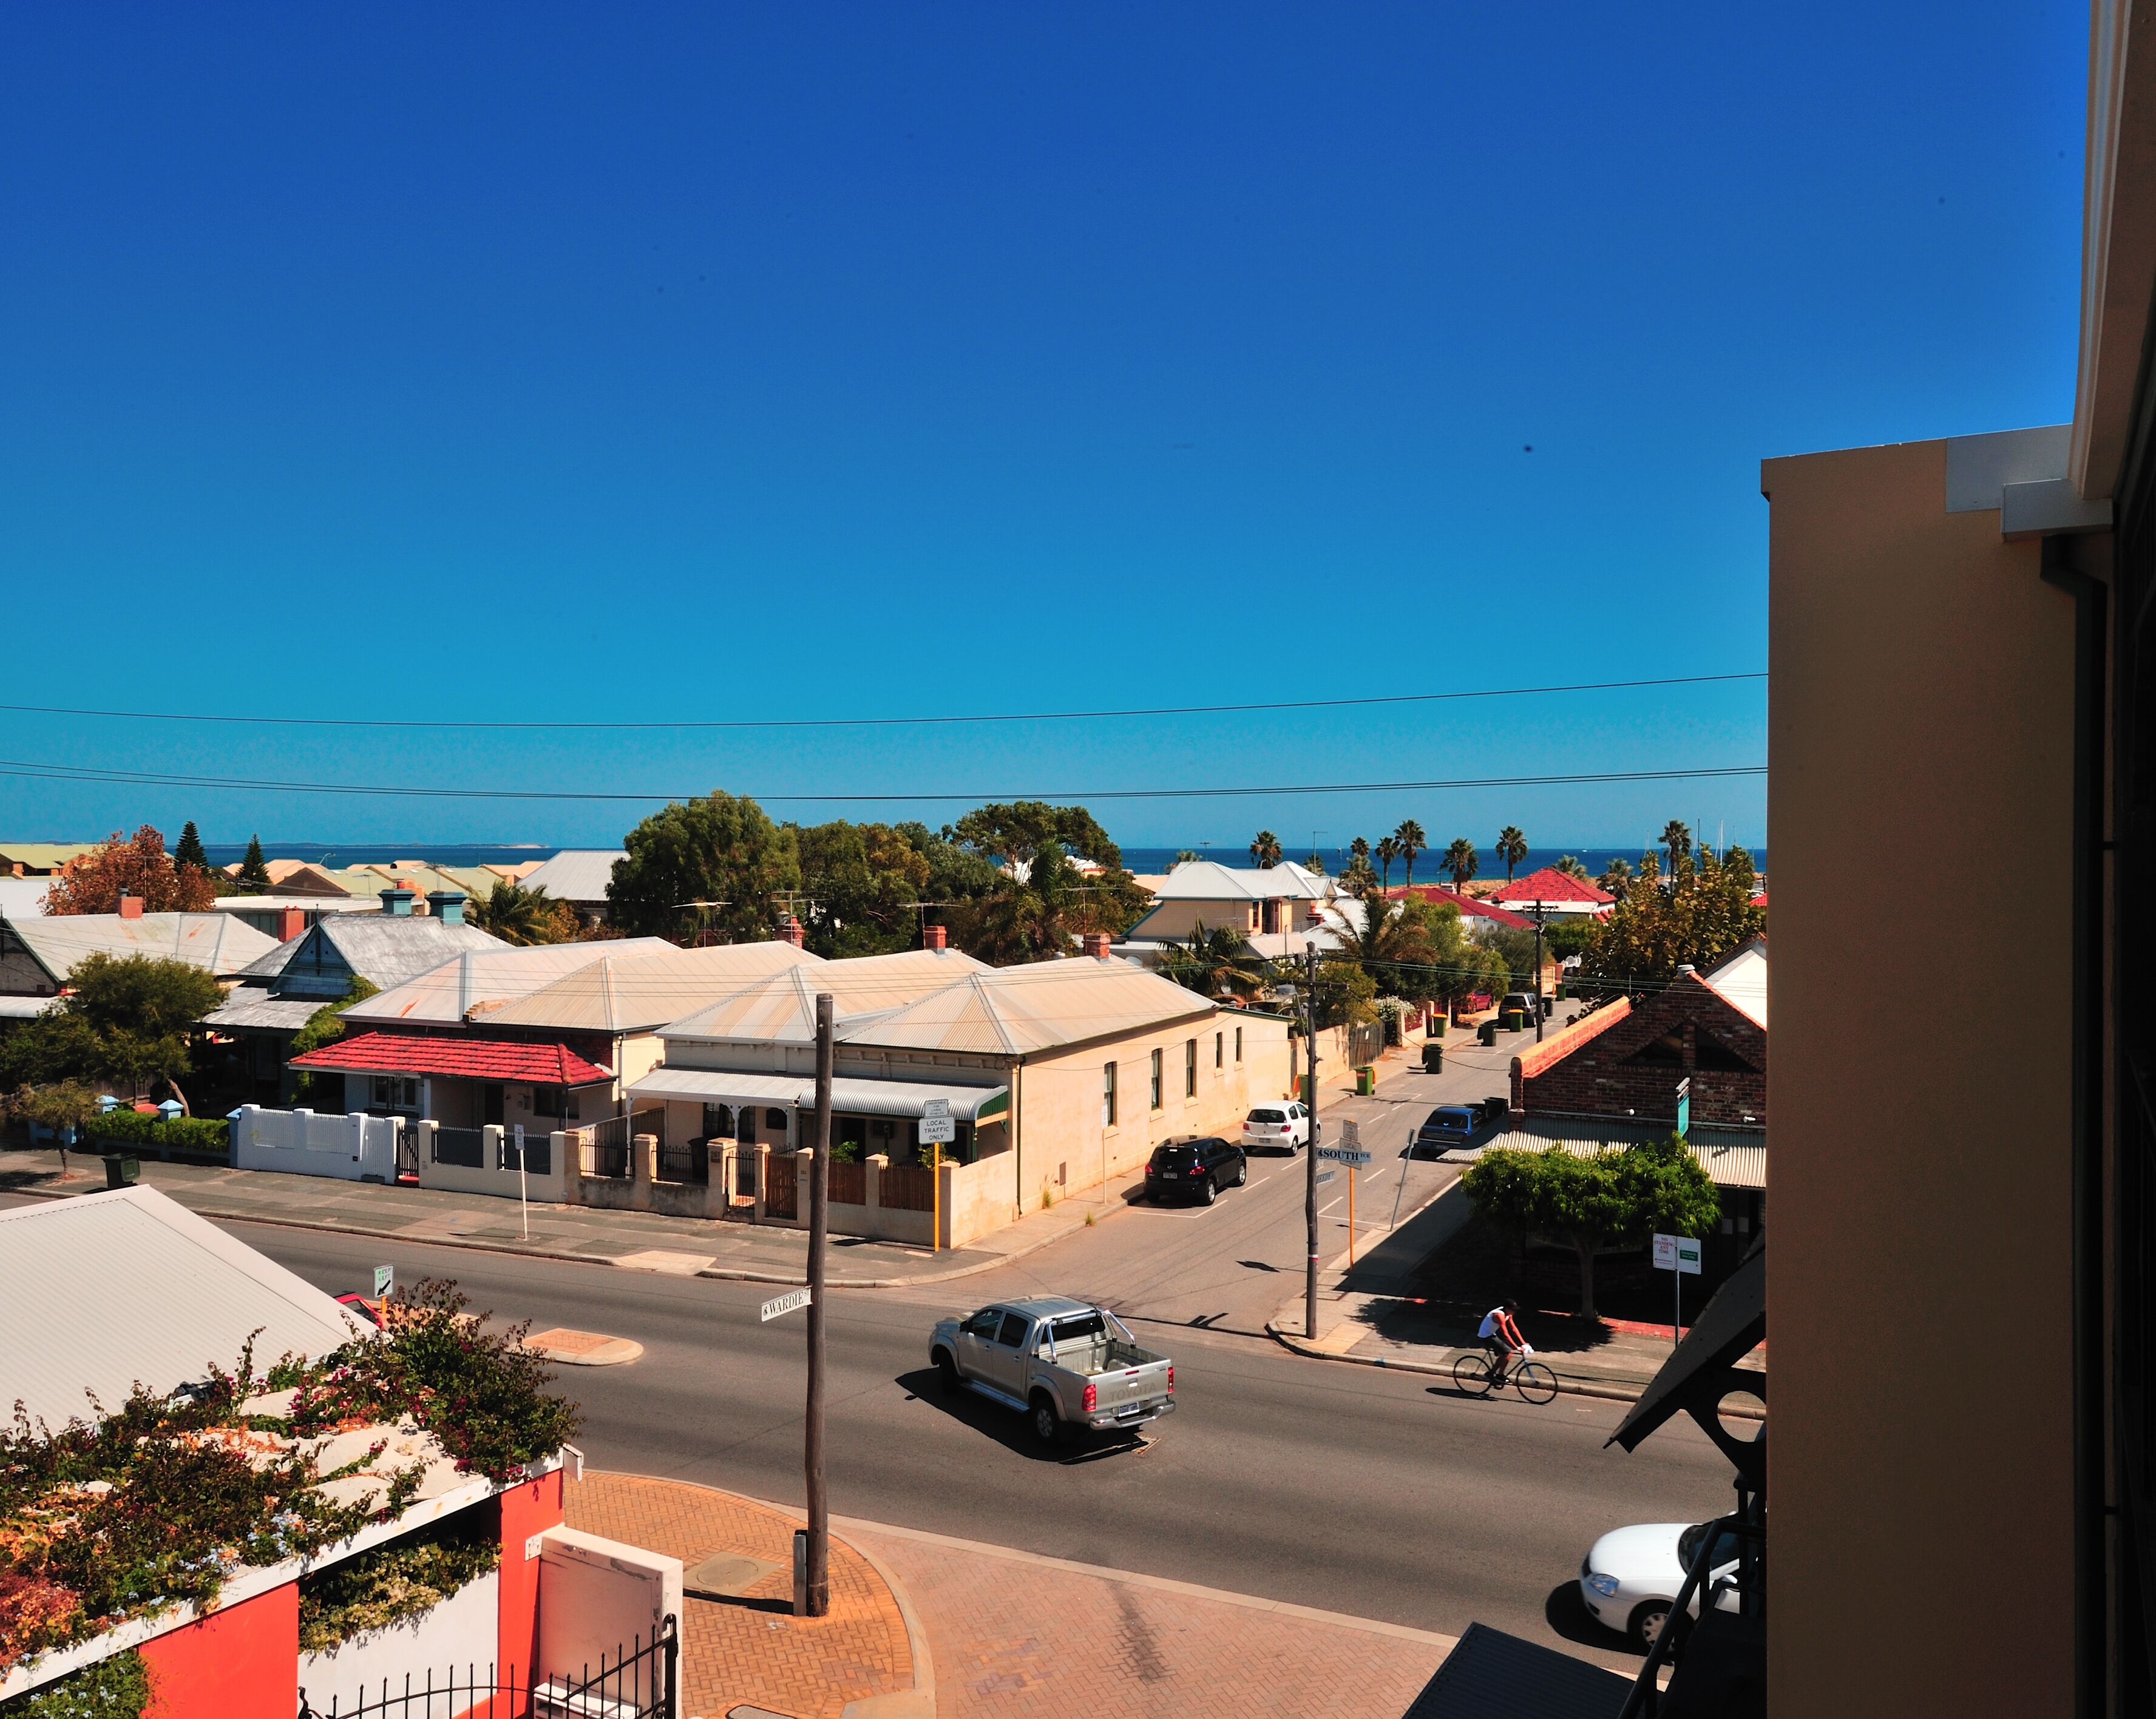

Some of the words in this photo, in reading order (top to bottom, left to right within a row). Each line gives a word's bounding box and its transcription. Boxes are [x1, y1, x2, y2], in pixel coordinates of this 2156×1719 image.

[1323, 1149, 1358, 1161] SOUTH
[769, 1292, 804, 1315] WARDIE
[1110, 1383, 1156, 1402] TOYOTA
